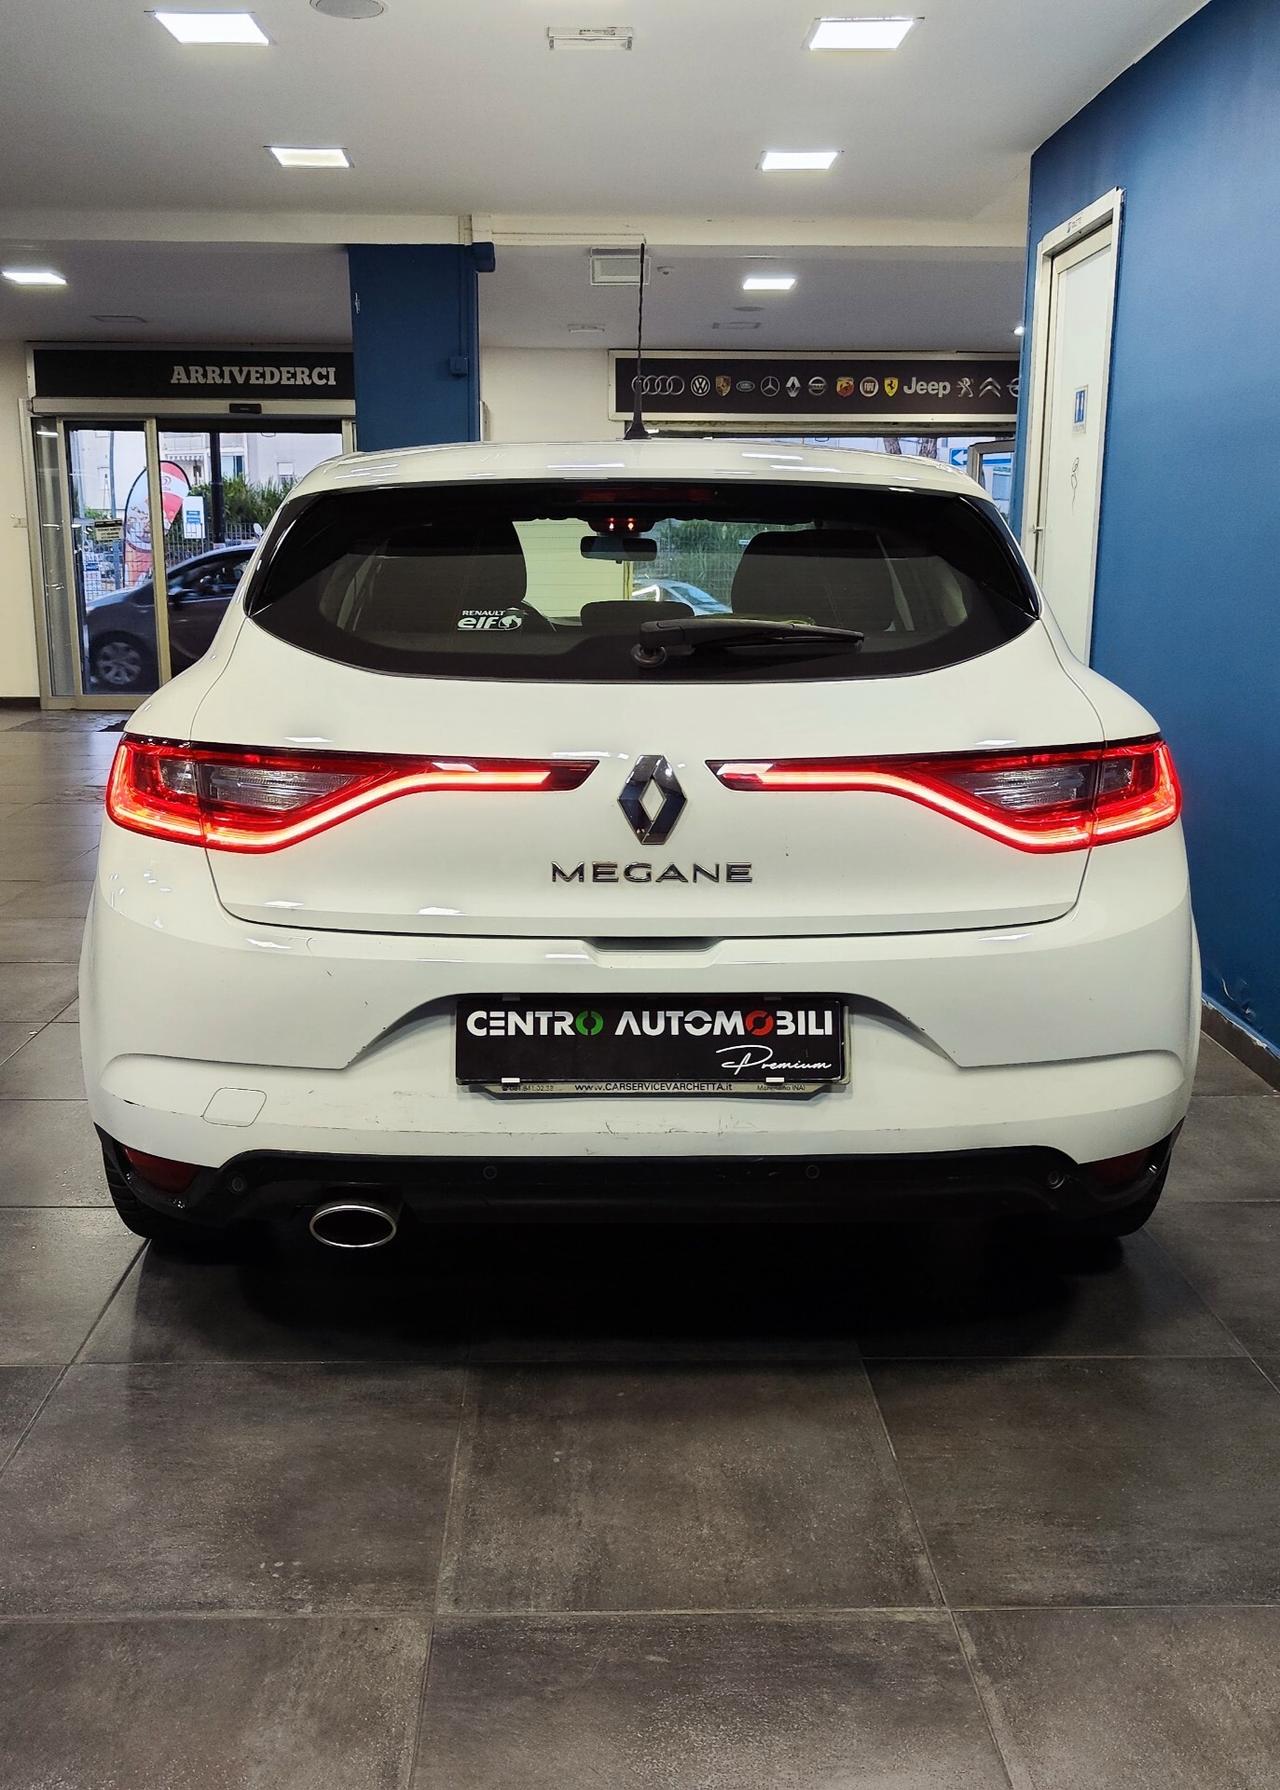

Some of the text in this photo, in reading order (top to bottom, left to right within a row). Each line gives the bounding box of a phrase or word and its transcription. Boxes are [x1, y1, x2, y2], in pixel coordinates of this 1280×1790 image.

[170, 366, 337, 386] ARRIVEDERCI
[903, 377, 951, 397] Jeep
[551, 861, 753, 883] MEGANE
[466, 1010, 832, 1037] CENTRO AUTOMOBILI
[716, 1044, 832, 1075] Premium
